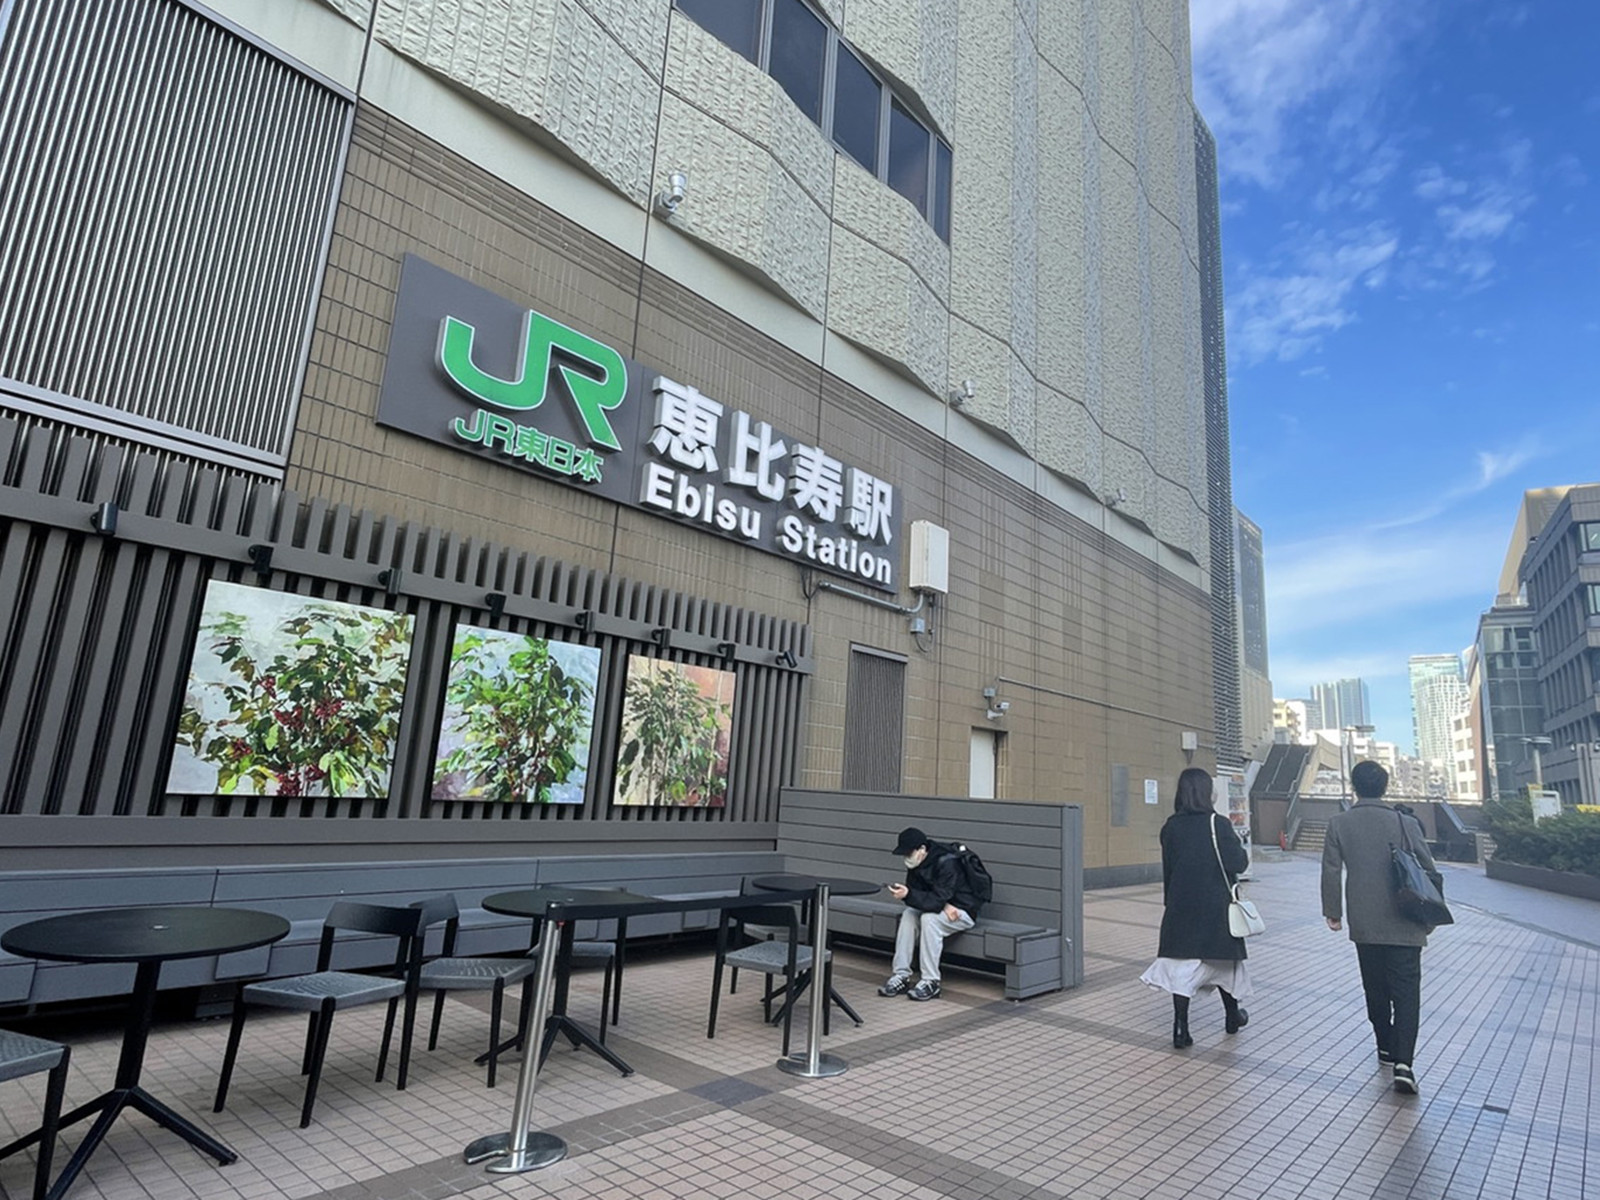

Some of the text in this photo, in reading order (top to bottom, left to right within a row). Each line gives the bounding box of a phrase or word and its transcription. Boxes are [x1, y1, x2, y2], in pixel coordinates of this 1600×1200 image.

[438, 309, 628, 451] JR
[450, 408, 604, 483] JR東日本
[640, 462, 891, 584] Ebisu Station
[647, 375, 893, 545] 恵比寿駅
